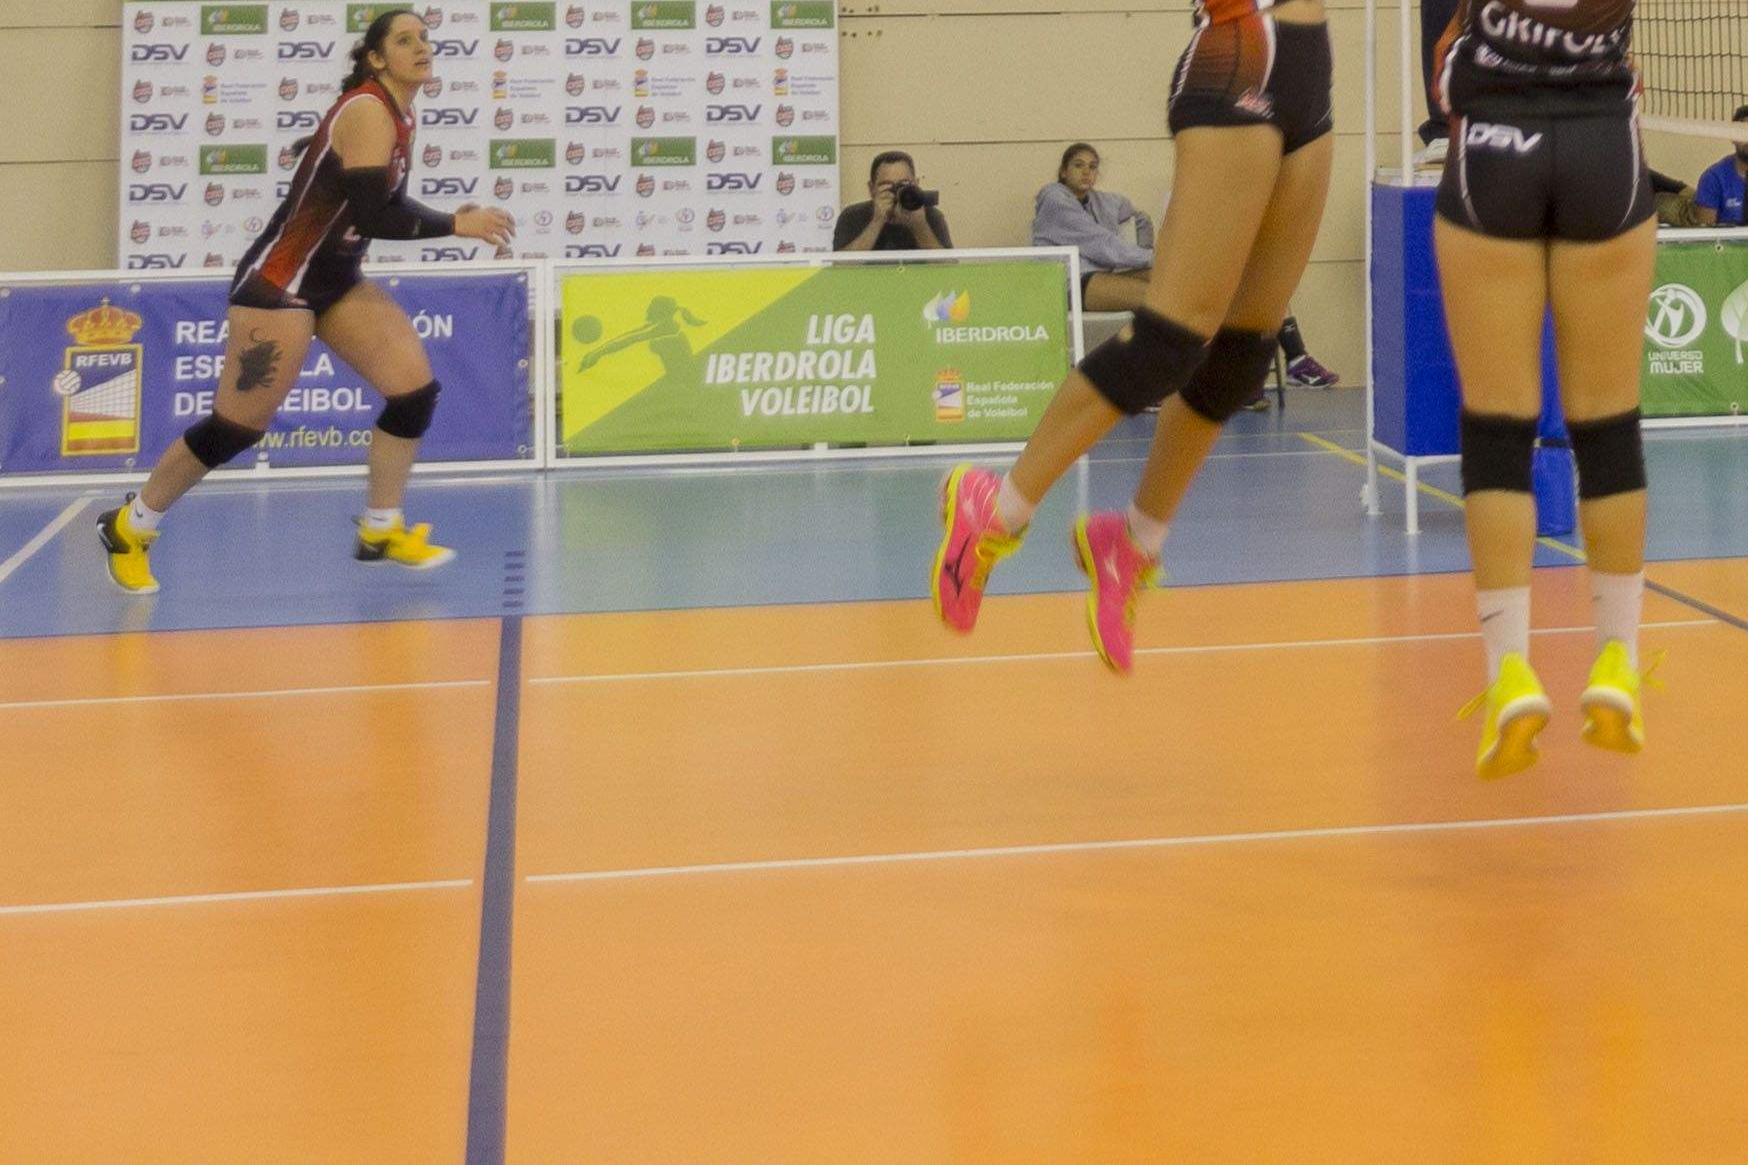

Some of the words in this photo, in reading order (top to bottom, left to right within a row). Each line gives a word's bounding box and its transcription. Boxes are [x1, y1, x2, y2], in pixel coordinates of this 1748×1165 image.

[131, 43, 190, 62] DSV
[277, 41, 335, 59] DSV
[565, 38, 622, 55] DSV
[706, 36, 761, 54] DSV
[130, 113, 188, 131] DSV
[421, 108, 479, 125] DSV
[565, 105, 622, 123] DSV
[706, 104, 762, 122] DSV
[1467, 122, 1543, 153] DSV
[421, 177, 479, 195] DSV
[565, 175, 622, 192] DSV
[706, 172, 762, 190] DSV
[129, 183, 188, 202] DSV
[175, 320, 230, 345] REA
[806, 314, 876, 345] LIGA
[936, 325, 1049, 343] IBERDROLA
[75, 353, 132, 369] RFEVB
[1648, 350, 1703, 361] UNIVERSO
[705, 350, 877, 384] IBERDROLA
[1650, 360, 1704, 374] MUJER
[966, 382, 991, 392] Real
[175, 391, 214, 416] DE
[740, 385, 875, 417] VOLEIBOL
